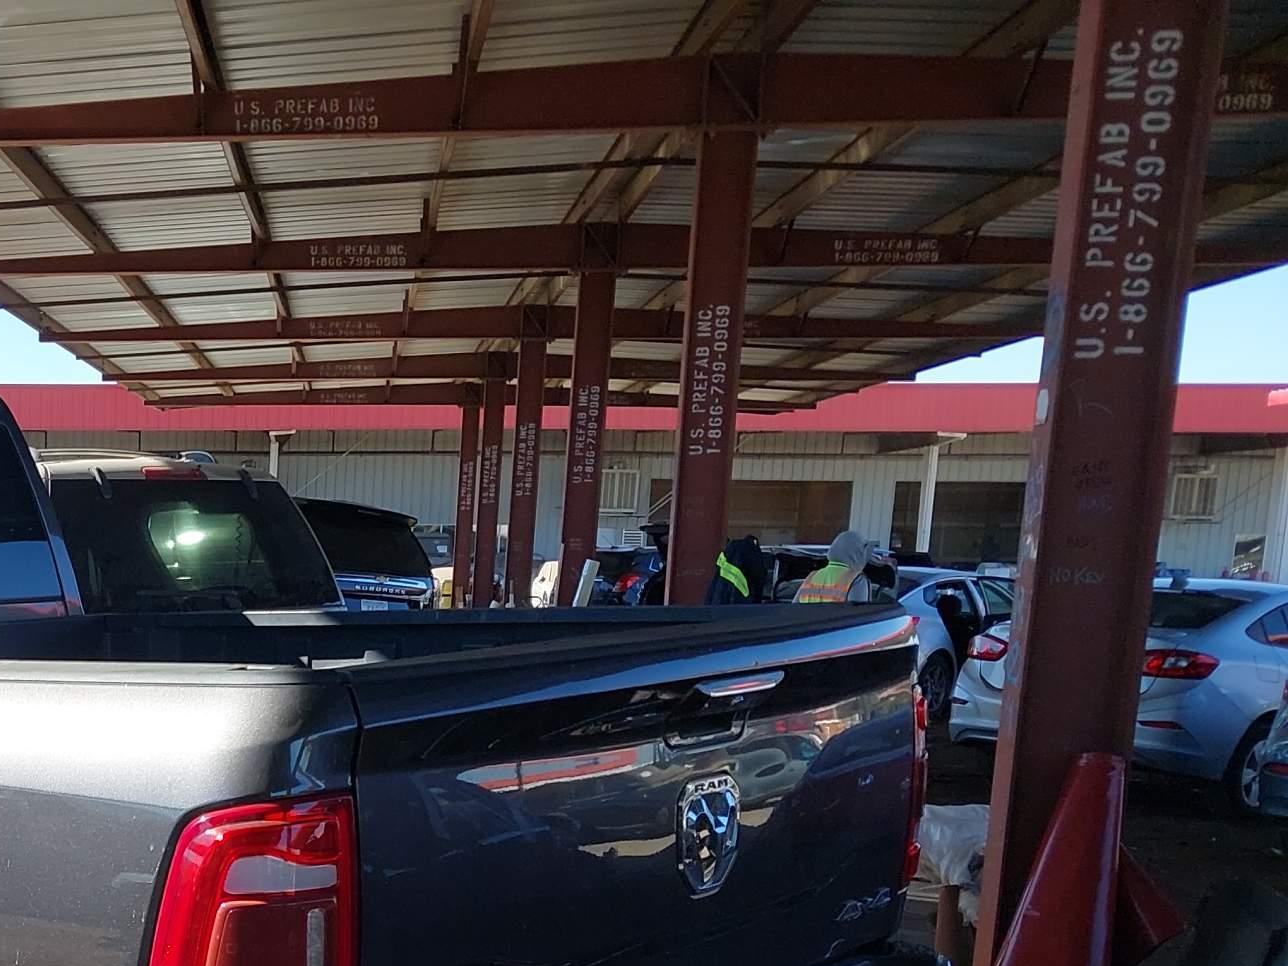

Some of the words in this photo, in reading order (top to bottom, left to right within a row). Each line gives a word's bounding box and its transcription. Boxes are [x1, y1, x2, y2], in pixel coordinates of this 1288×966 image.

[1104, 27, 1144, 100] INC.
[236, 114, 379, 132] 1-866-799-0969
[275, 98, 340, 115] PREFAB
[1085, 122, 1130, 267] PREFAB
[1113, 29, 1185, 355] 1-866-799-0969
[696, 303, 714, 337] INC.
[1074, 290, 1112, 359] U.S.
[692, 346, 710, 413] PREFAB
[706, 305, 731, 454] 1-866-799-0969
[574, 412, 587, 456] PREFAB
[689, 422, 705, 455] U.S.
[694, 778, 729, 793] RAM
